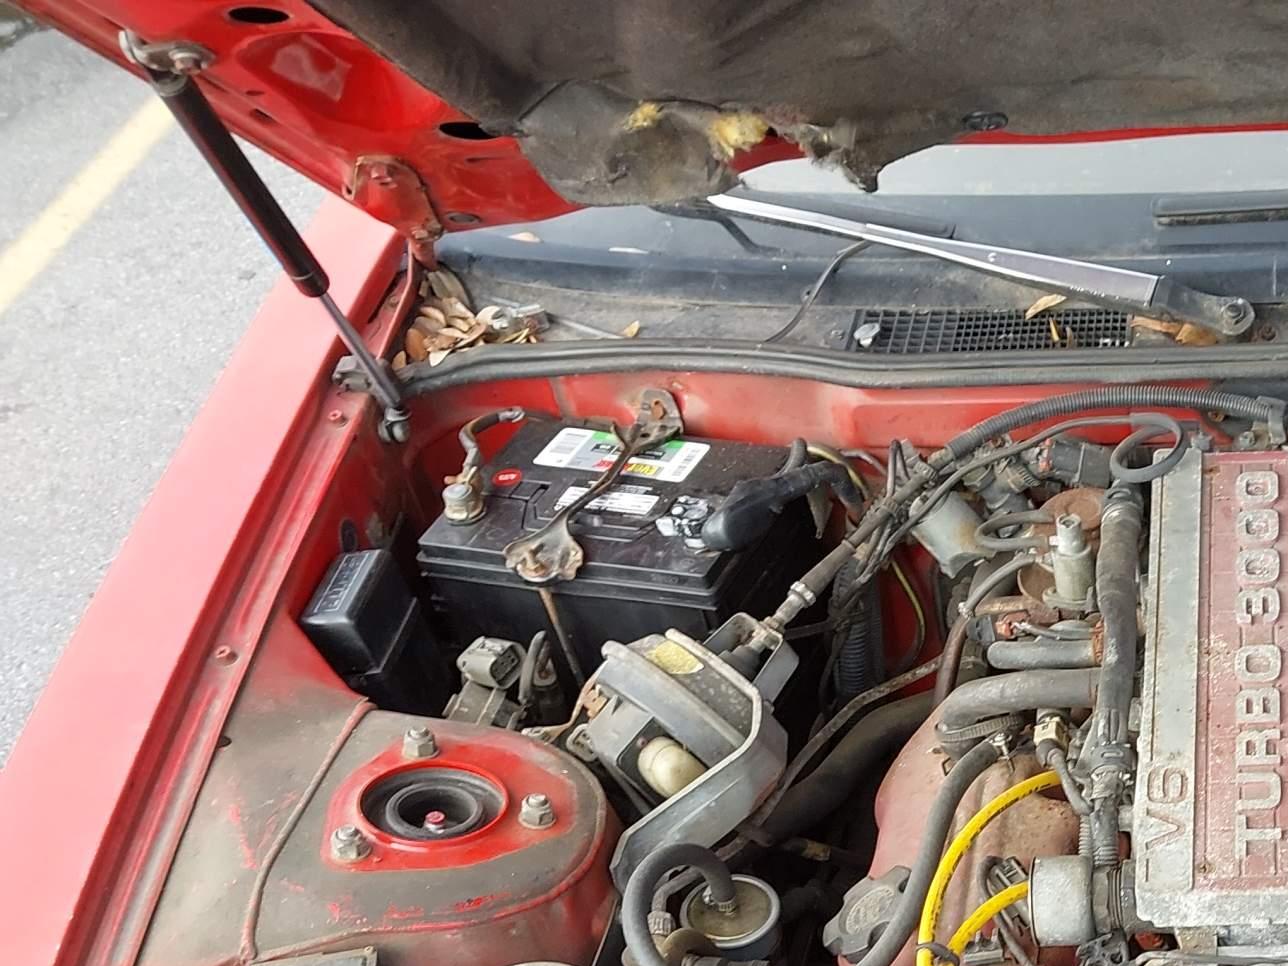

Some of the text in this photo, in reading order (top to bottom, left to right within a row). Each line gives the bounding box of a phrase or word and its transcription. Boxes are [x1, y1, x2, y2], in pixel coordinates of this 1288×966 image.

[1234, 469, 1283, 861] TURBO 3000
[1145, 764, 1189, 851] V6
